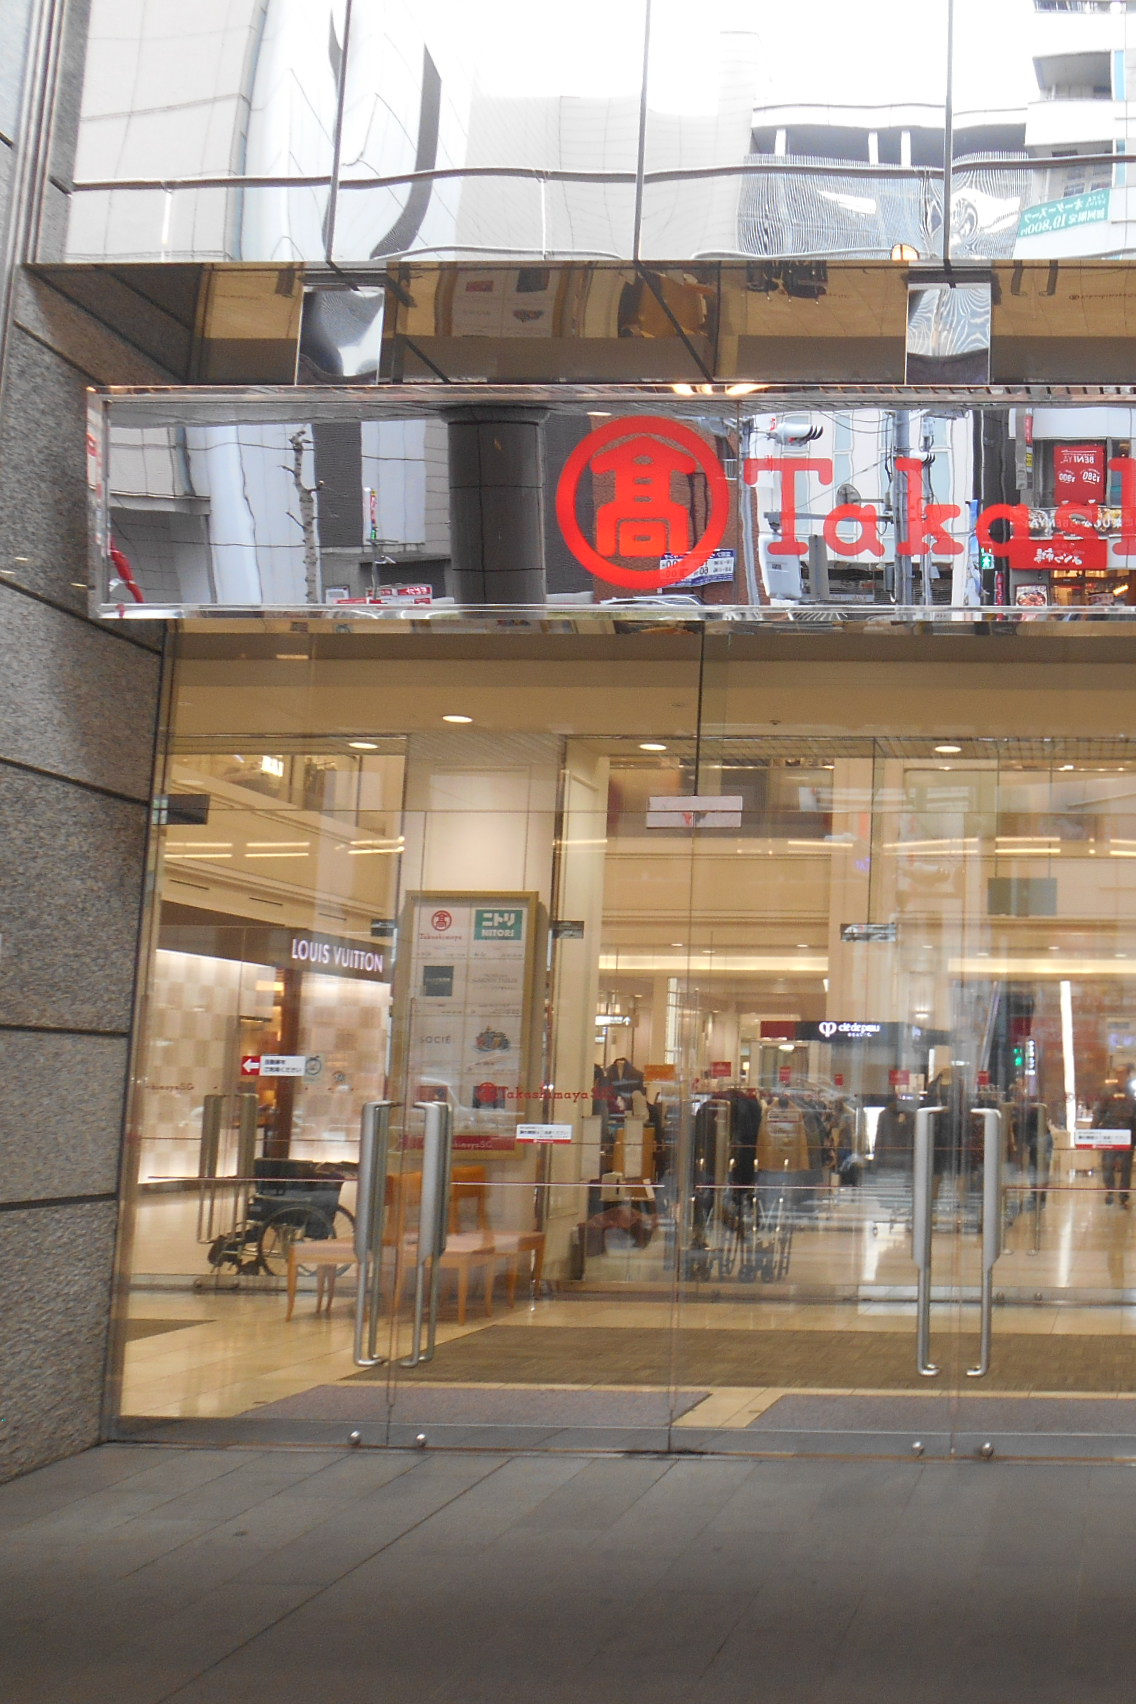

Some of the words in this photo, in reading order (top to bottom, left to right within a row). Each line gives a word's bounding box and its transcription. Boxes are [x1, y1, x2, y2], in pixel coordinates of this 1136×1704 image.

[482, 912, 516, 926] ニトリ
[481, 929, 515, 937] NITORI
[292, 938, 330, 965] LOUIS
[333, 946, 384, 973] VUITTON
[499, 1084, 589, 1103] Takashimaya
